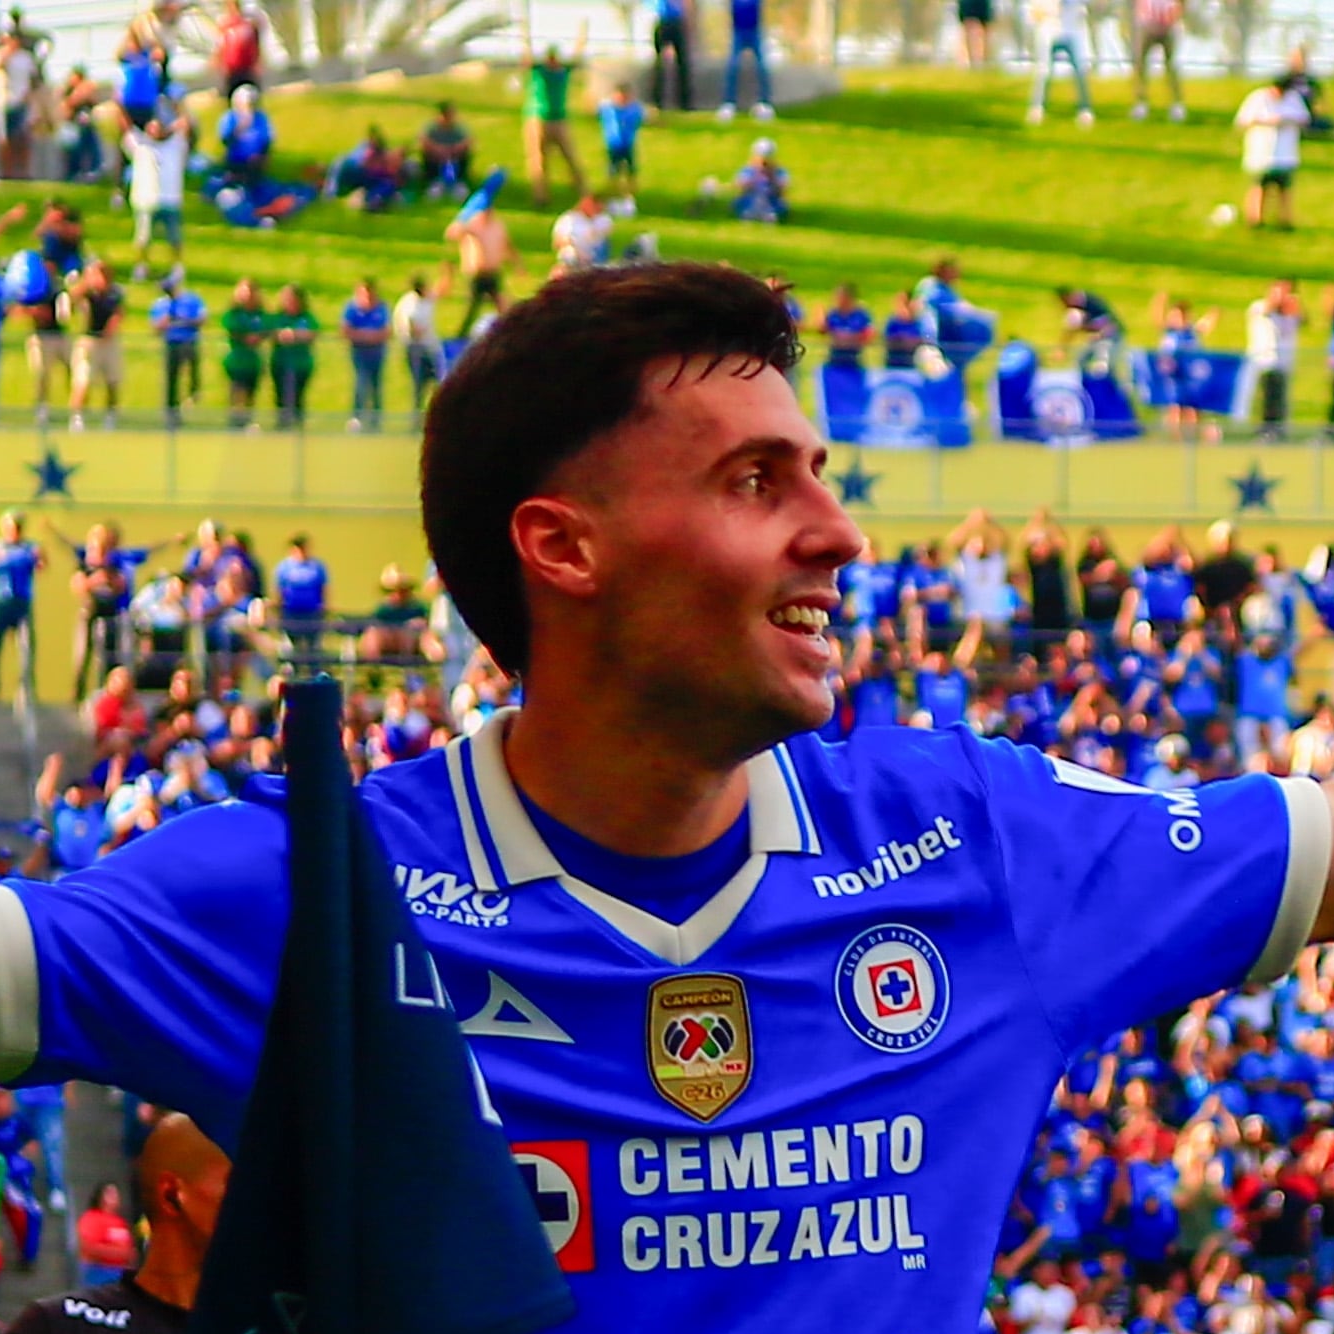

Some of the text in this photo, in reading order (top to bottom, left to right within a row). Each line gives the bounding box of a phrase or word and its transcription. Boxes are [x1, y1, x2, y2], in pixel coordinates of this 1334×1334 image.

[812, 815, 962, 898] novibet
[619, 1114, 924, 1196] CEMENTO
[621, 1194, 926, 1272] CRUZ AZUL
[901, 1253, 927, 1271] MR
